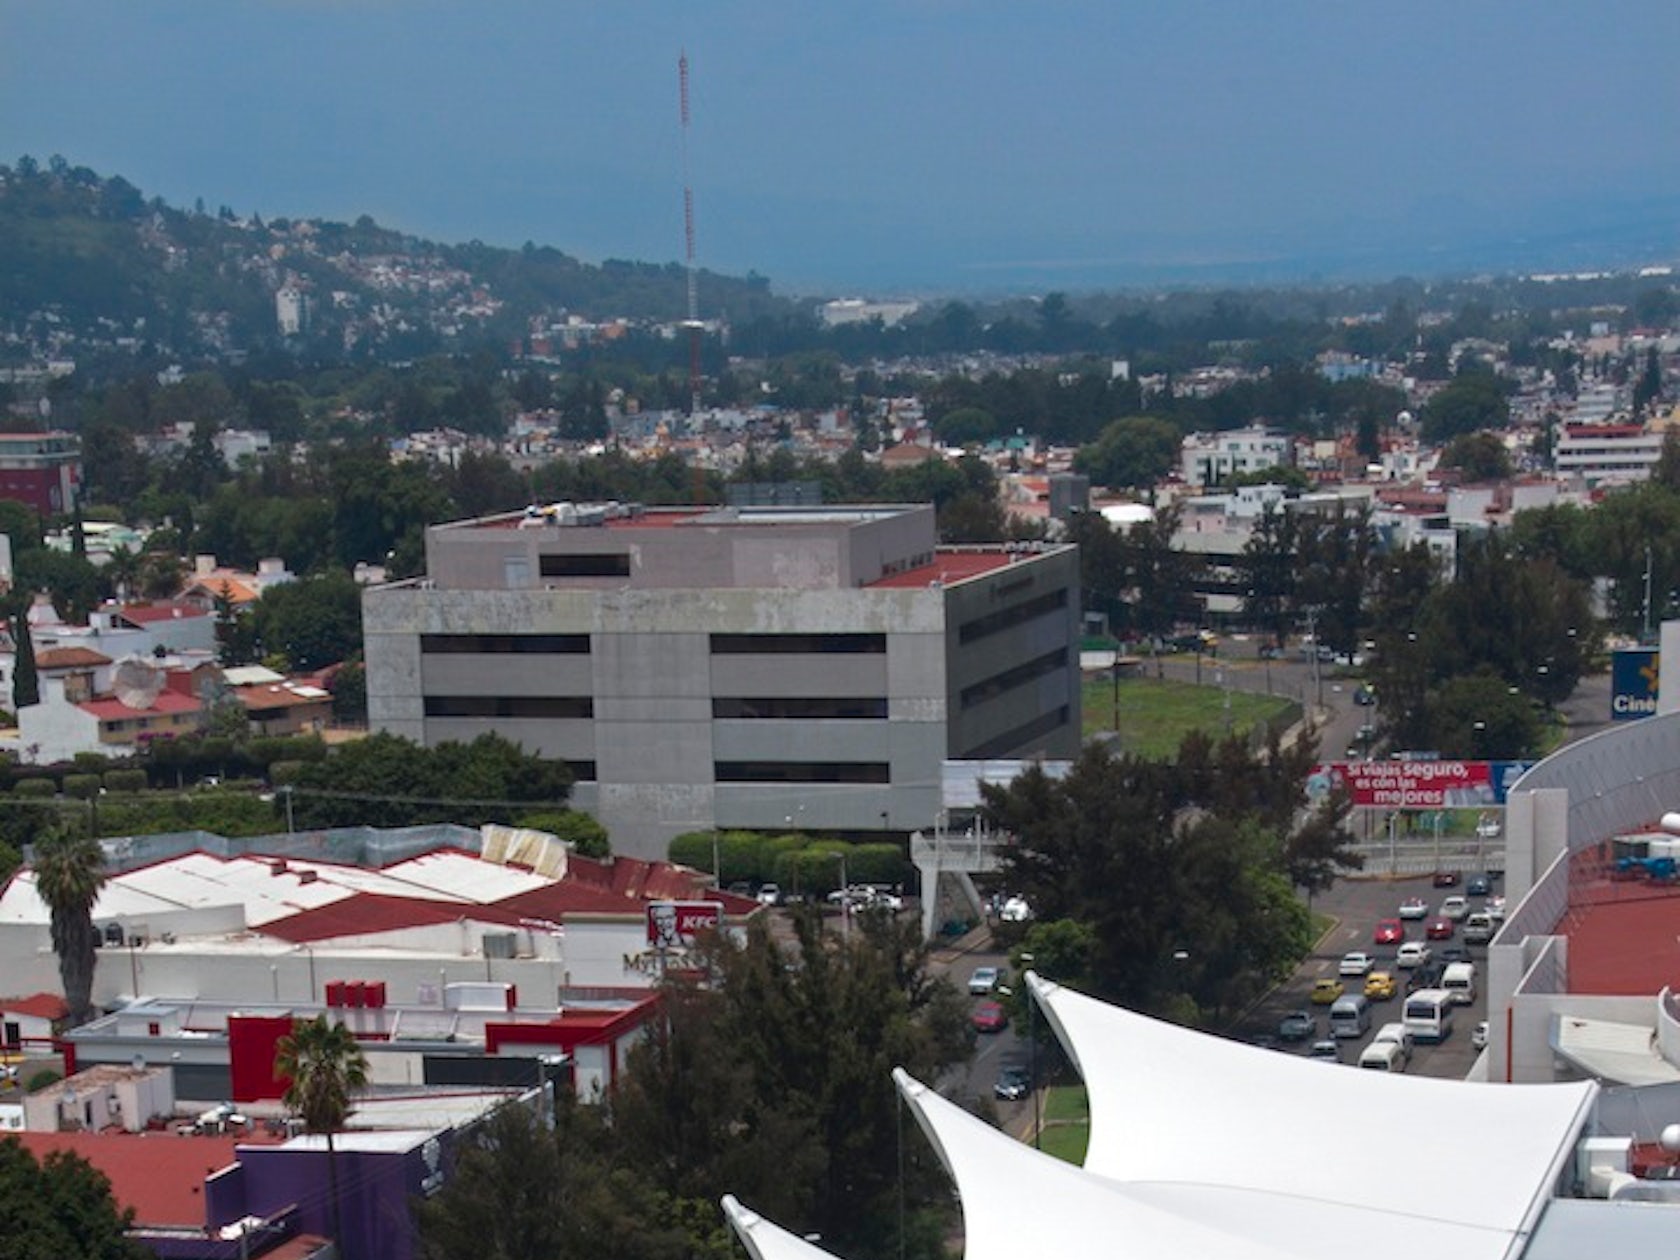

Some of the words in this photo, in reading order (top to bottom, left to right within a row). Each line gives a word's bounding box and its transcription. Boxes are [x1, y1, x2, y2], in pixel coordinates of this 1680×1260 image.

[1362, 763, 1401, 779] viajas
[1403, 762, 1468, 780] seguro,
[1355, 778, 1370, 789] es
[1397, 777, 1417, 789] las
[1374, 790, 1441, 806] mejores
[682, 916, 717, 929] KFC
